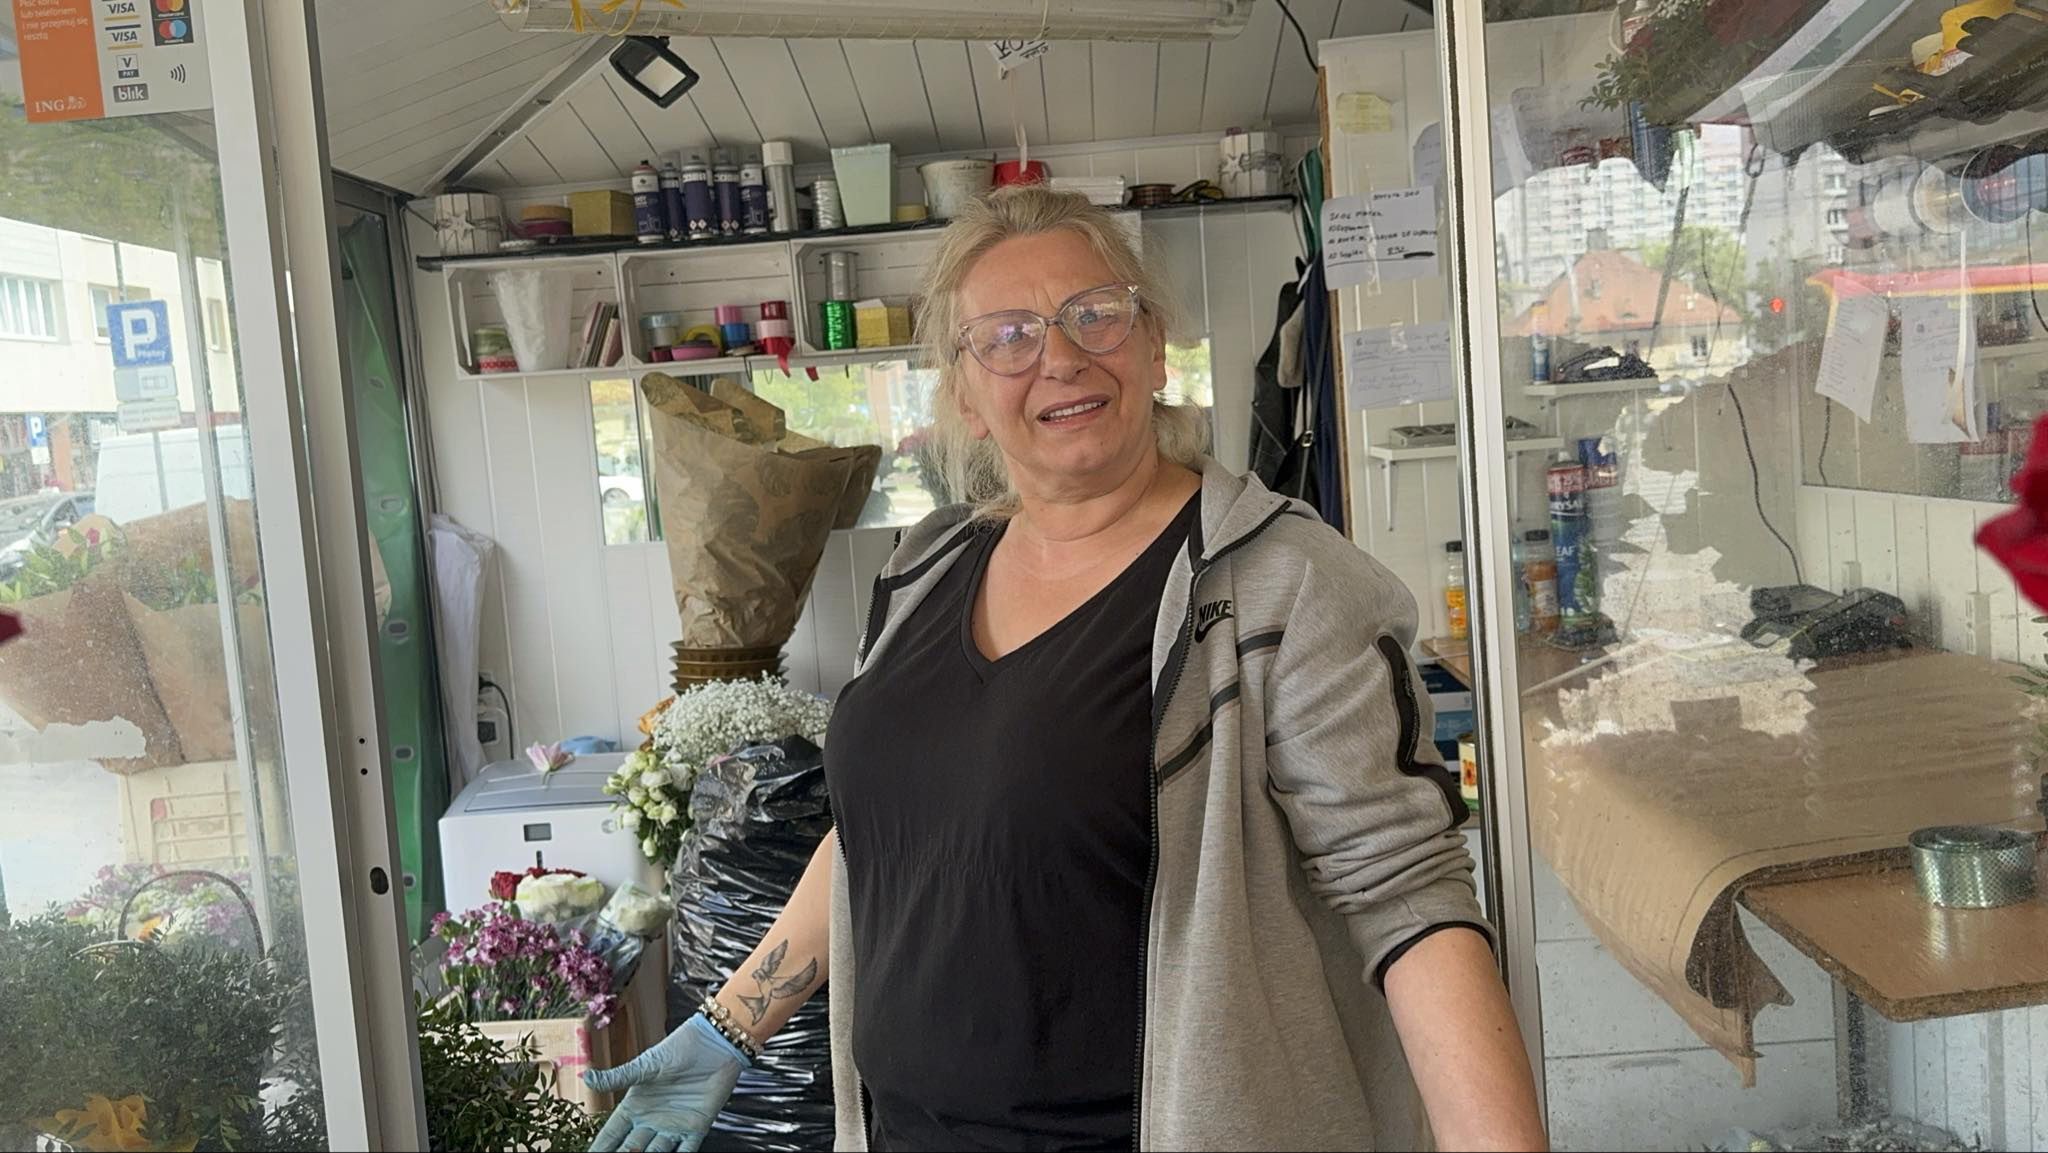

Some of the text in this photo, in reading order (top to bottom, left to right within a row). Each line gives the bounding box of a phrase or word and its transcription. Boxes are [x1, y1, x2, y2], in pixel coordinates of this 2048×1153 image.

[108, 2, 136, 14] VISA
[112, 31, 137, 42] VISA
[117, 86, 144, 101] blik
[35, 99, 65, 112] ING
[121, 308, 159, 361] P
[1199, 600, 1232, 627] NIKE
